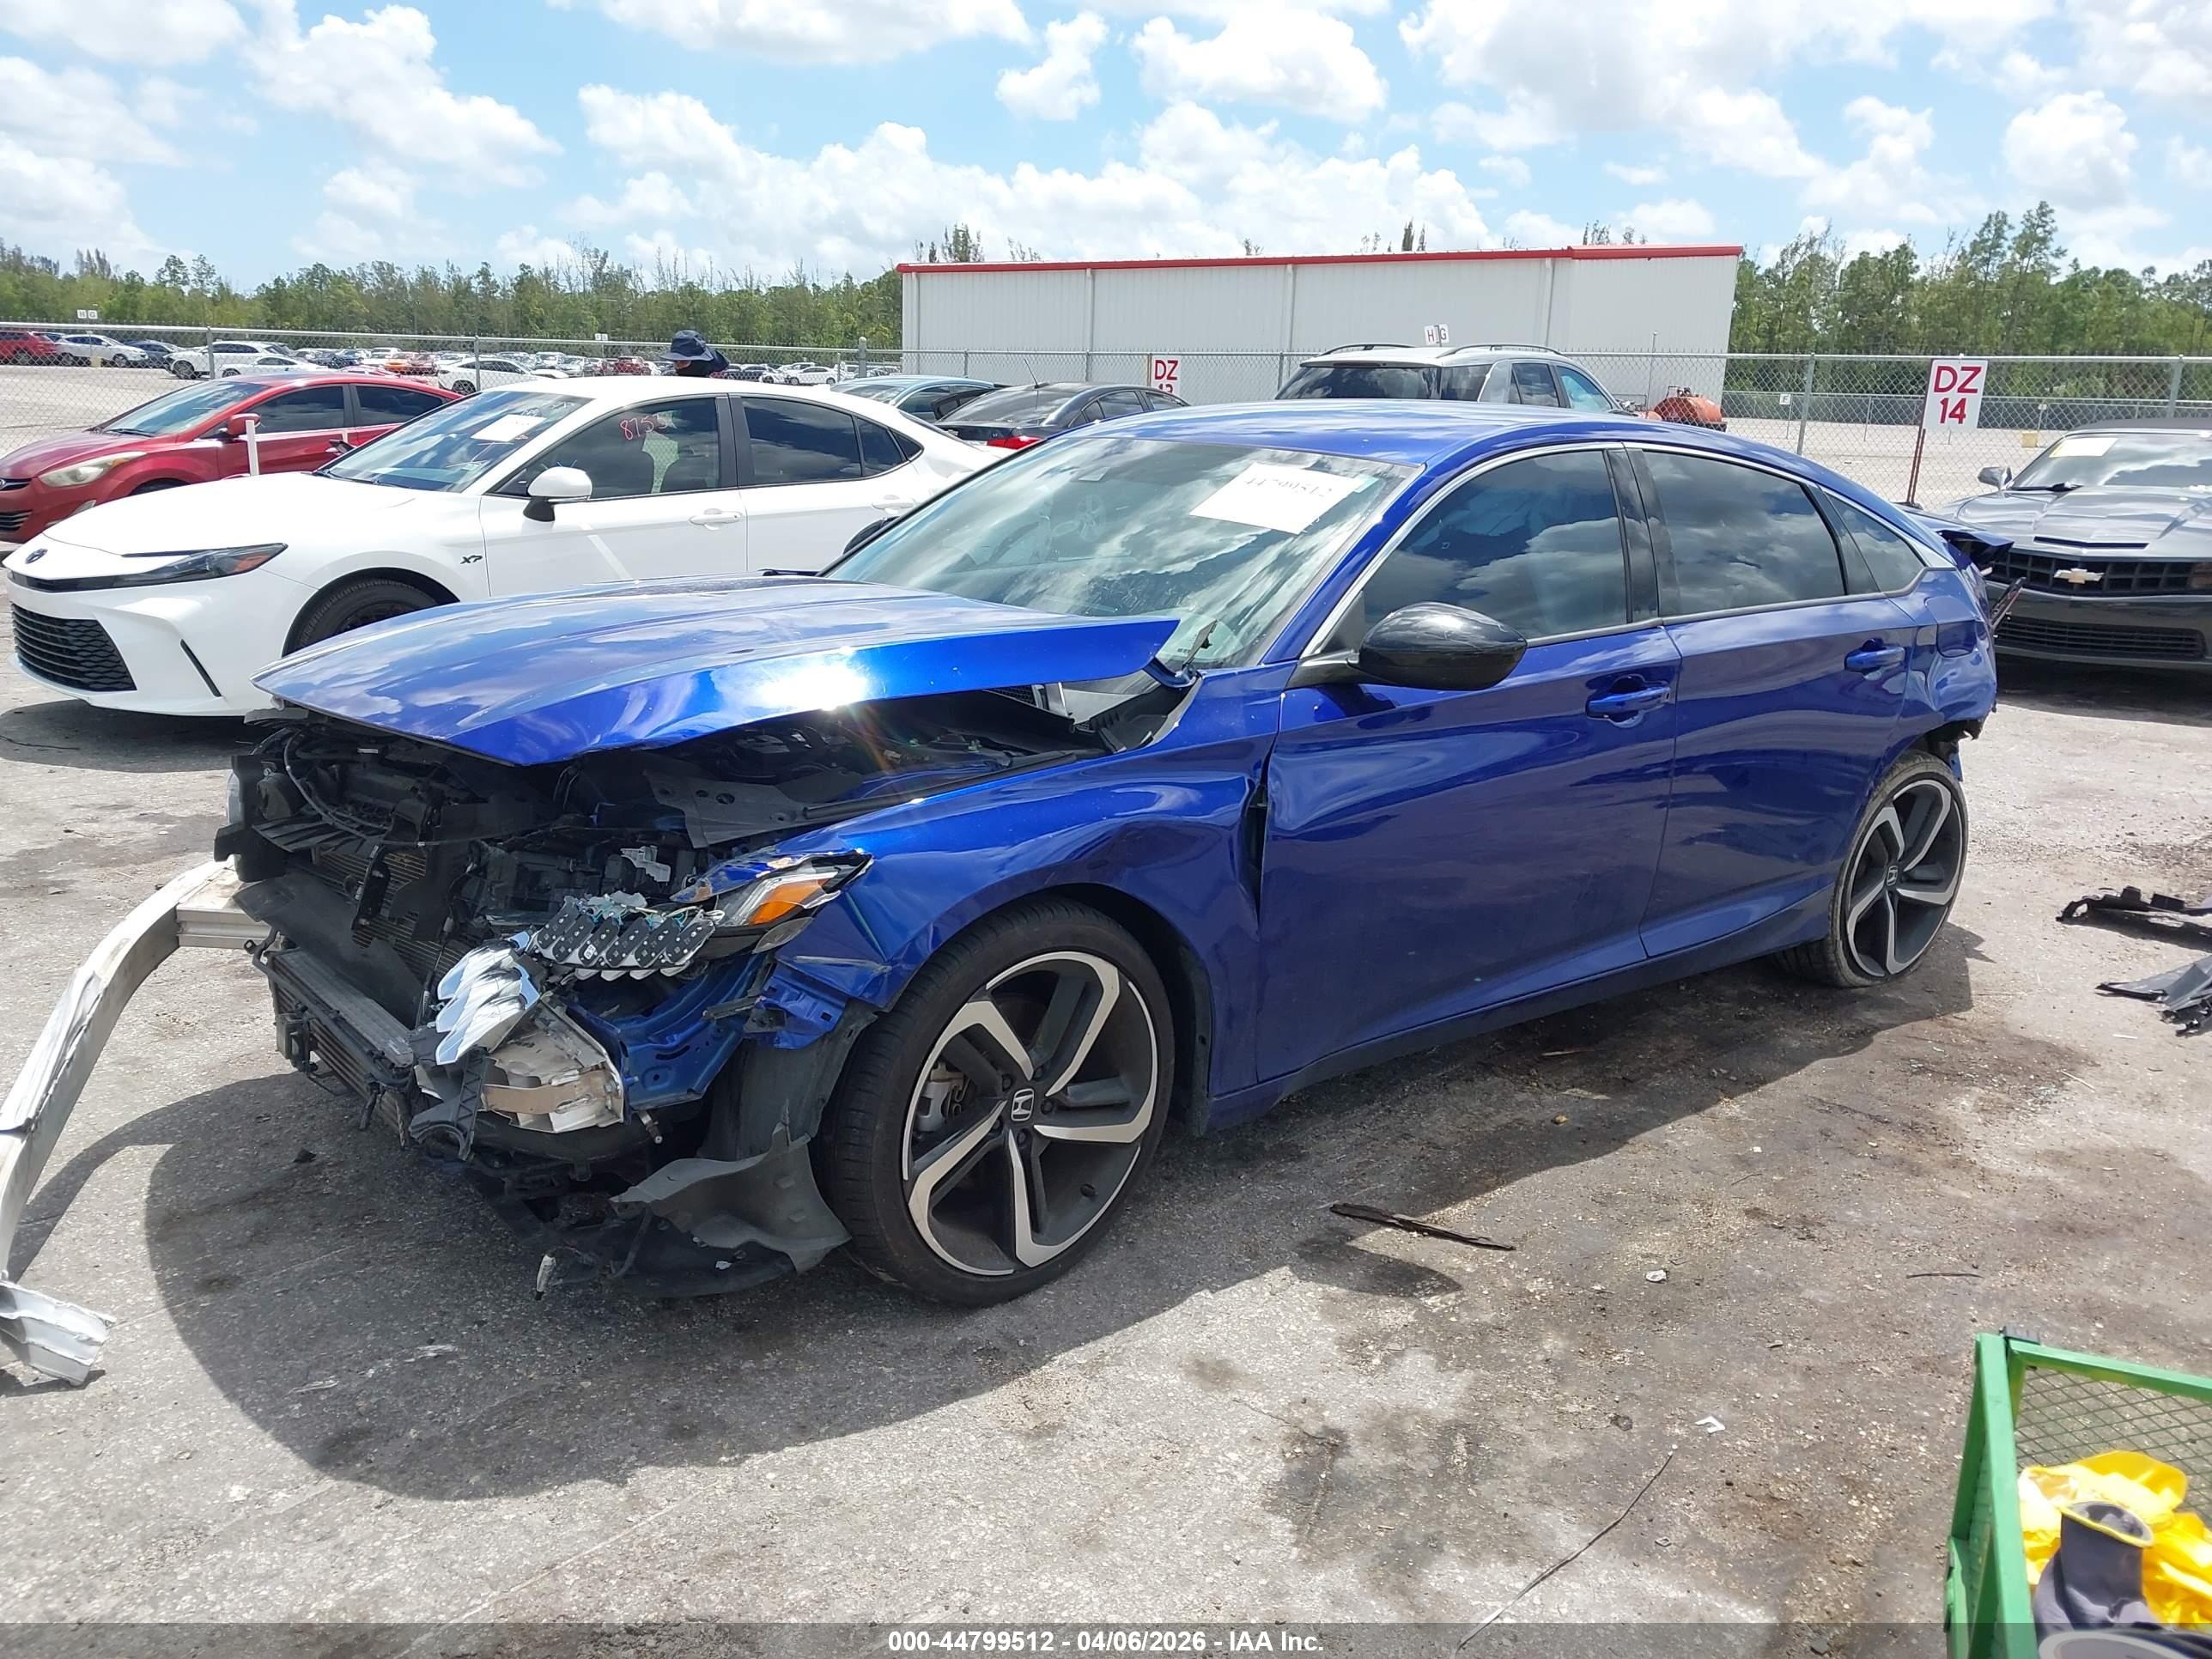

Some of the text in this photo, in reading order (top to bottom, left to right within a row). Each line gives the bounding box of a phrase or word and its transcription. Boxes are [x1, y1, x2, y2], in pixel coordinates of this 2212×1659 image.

[1427, 329, 1435, 342] H
[1154, 359, 1178, 380] DZ
[1934, 365, 1982, 393] DZ
[1940, 398, 1966, 424] 14
